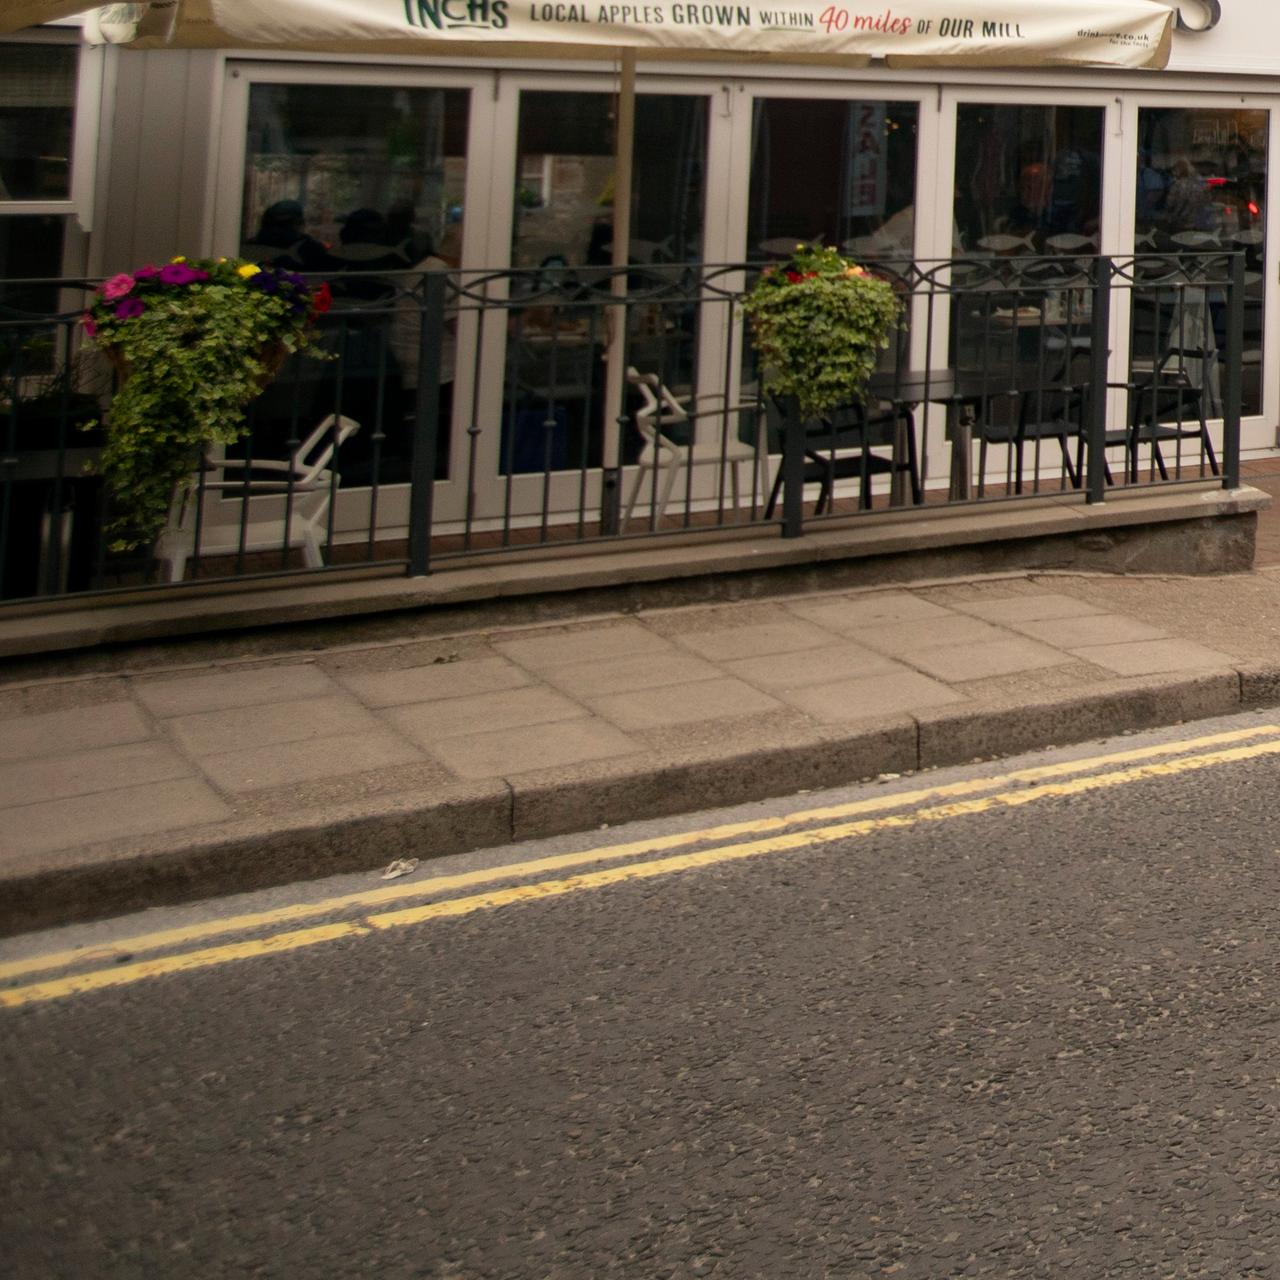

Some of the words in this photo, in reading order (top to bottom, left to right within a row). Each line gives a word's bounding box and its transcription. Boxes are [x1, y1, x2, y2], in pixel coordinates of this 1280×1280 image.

[530, 3, 590, 23] LOCAL
[599, 4, 664, 24] APPLES
[672, 4, 751, 26] GROWN
[759, 10, 814, 27] WITHIN
[819, 6, 849, 34] 40
[853, 9, 912, 35] miles
[917, 20, 933, 35] OF
[938, 18, 973, 38] OUR
[982, 21, 1026, 39] MILL
